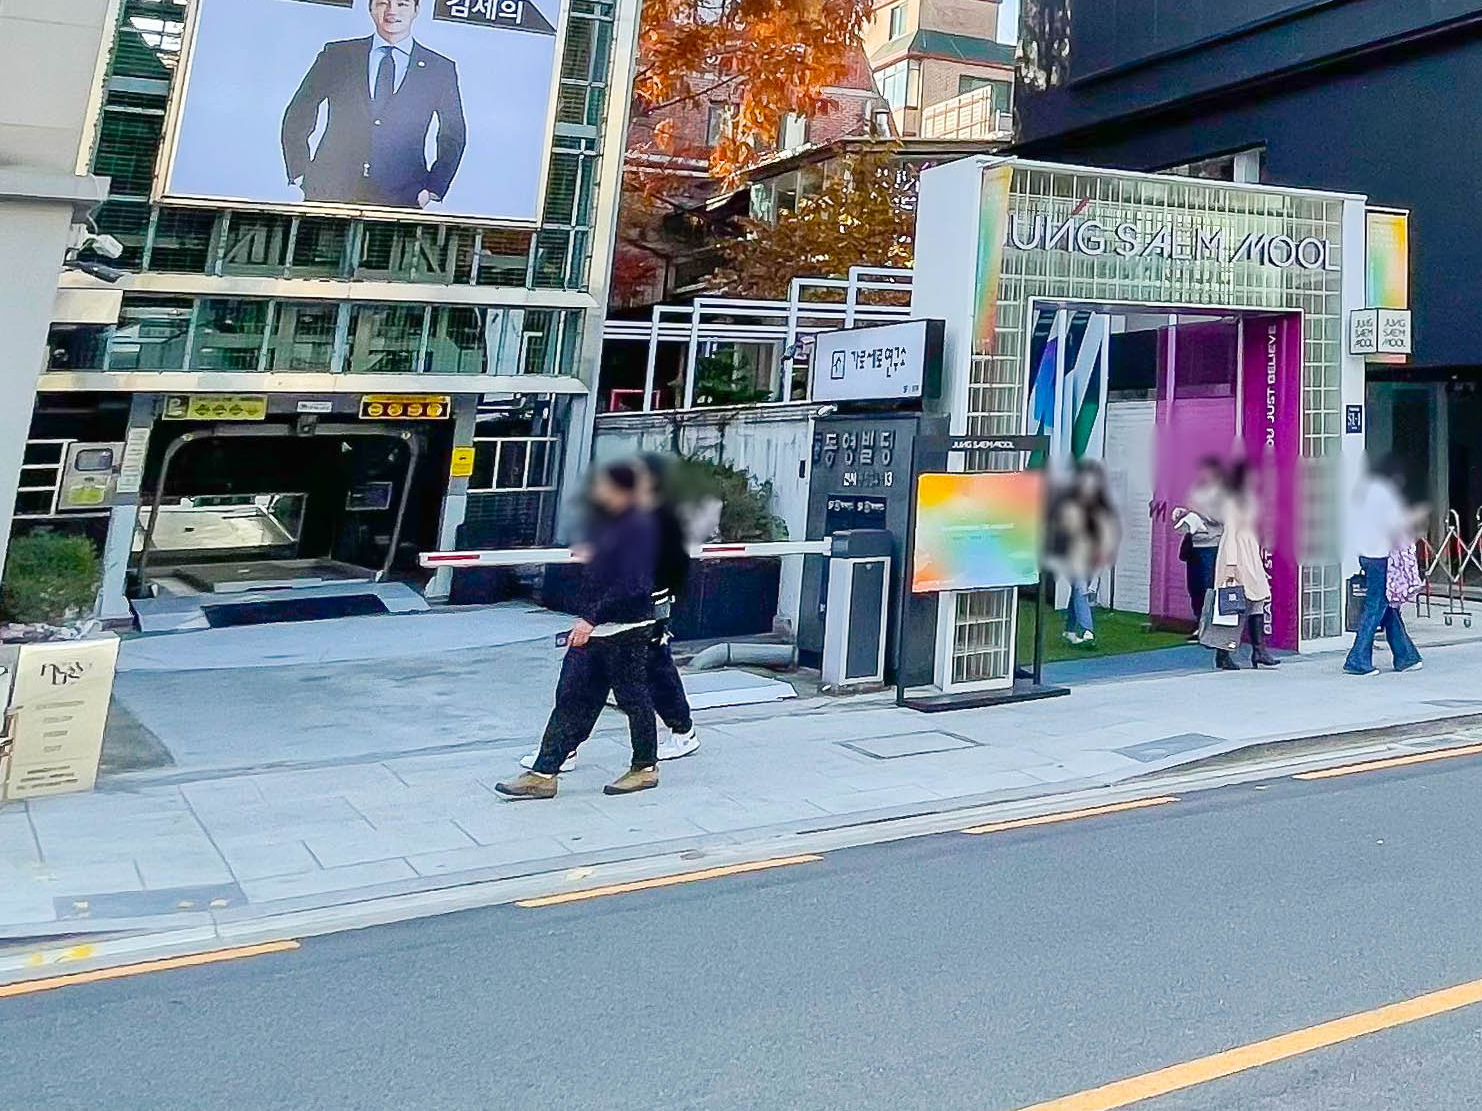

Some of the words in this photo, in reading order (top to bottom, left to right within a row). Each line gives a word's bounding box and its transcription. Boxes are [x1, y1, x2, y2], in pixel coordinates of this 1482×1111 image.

[1114, 222, 1224, 263] SAEM
[1229, 232, 1340, 271] MOOL
[1267, 324, 1276, 384] BELIEVE
[1266, 386, 1275, 423] JUST
